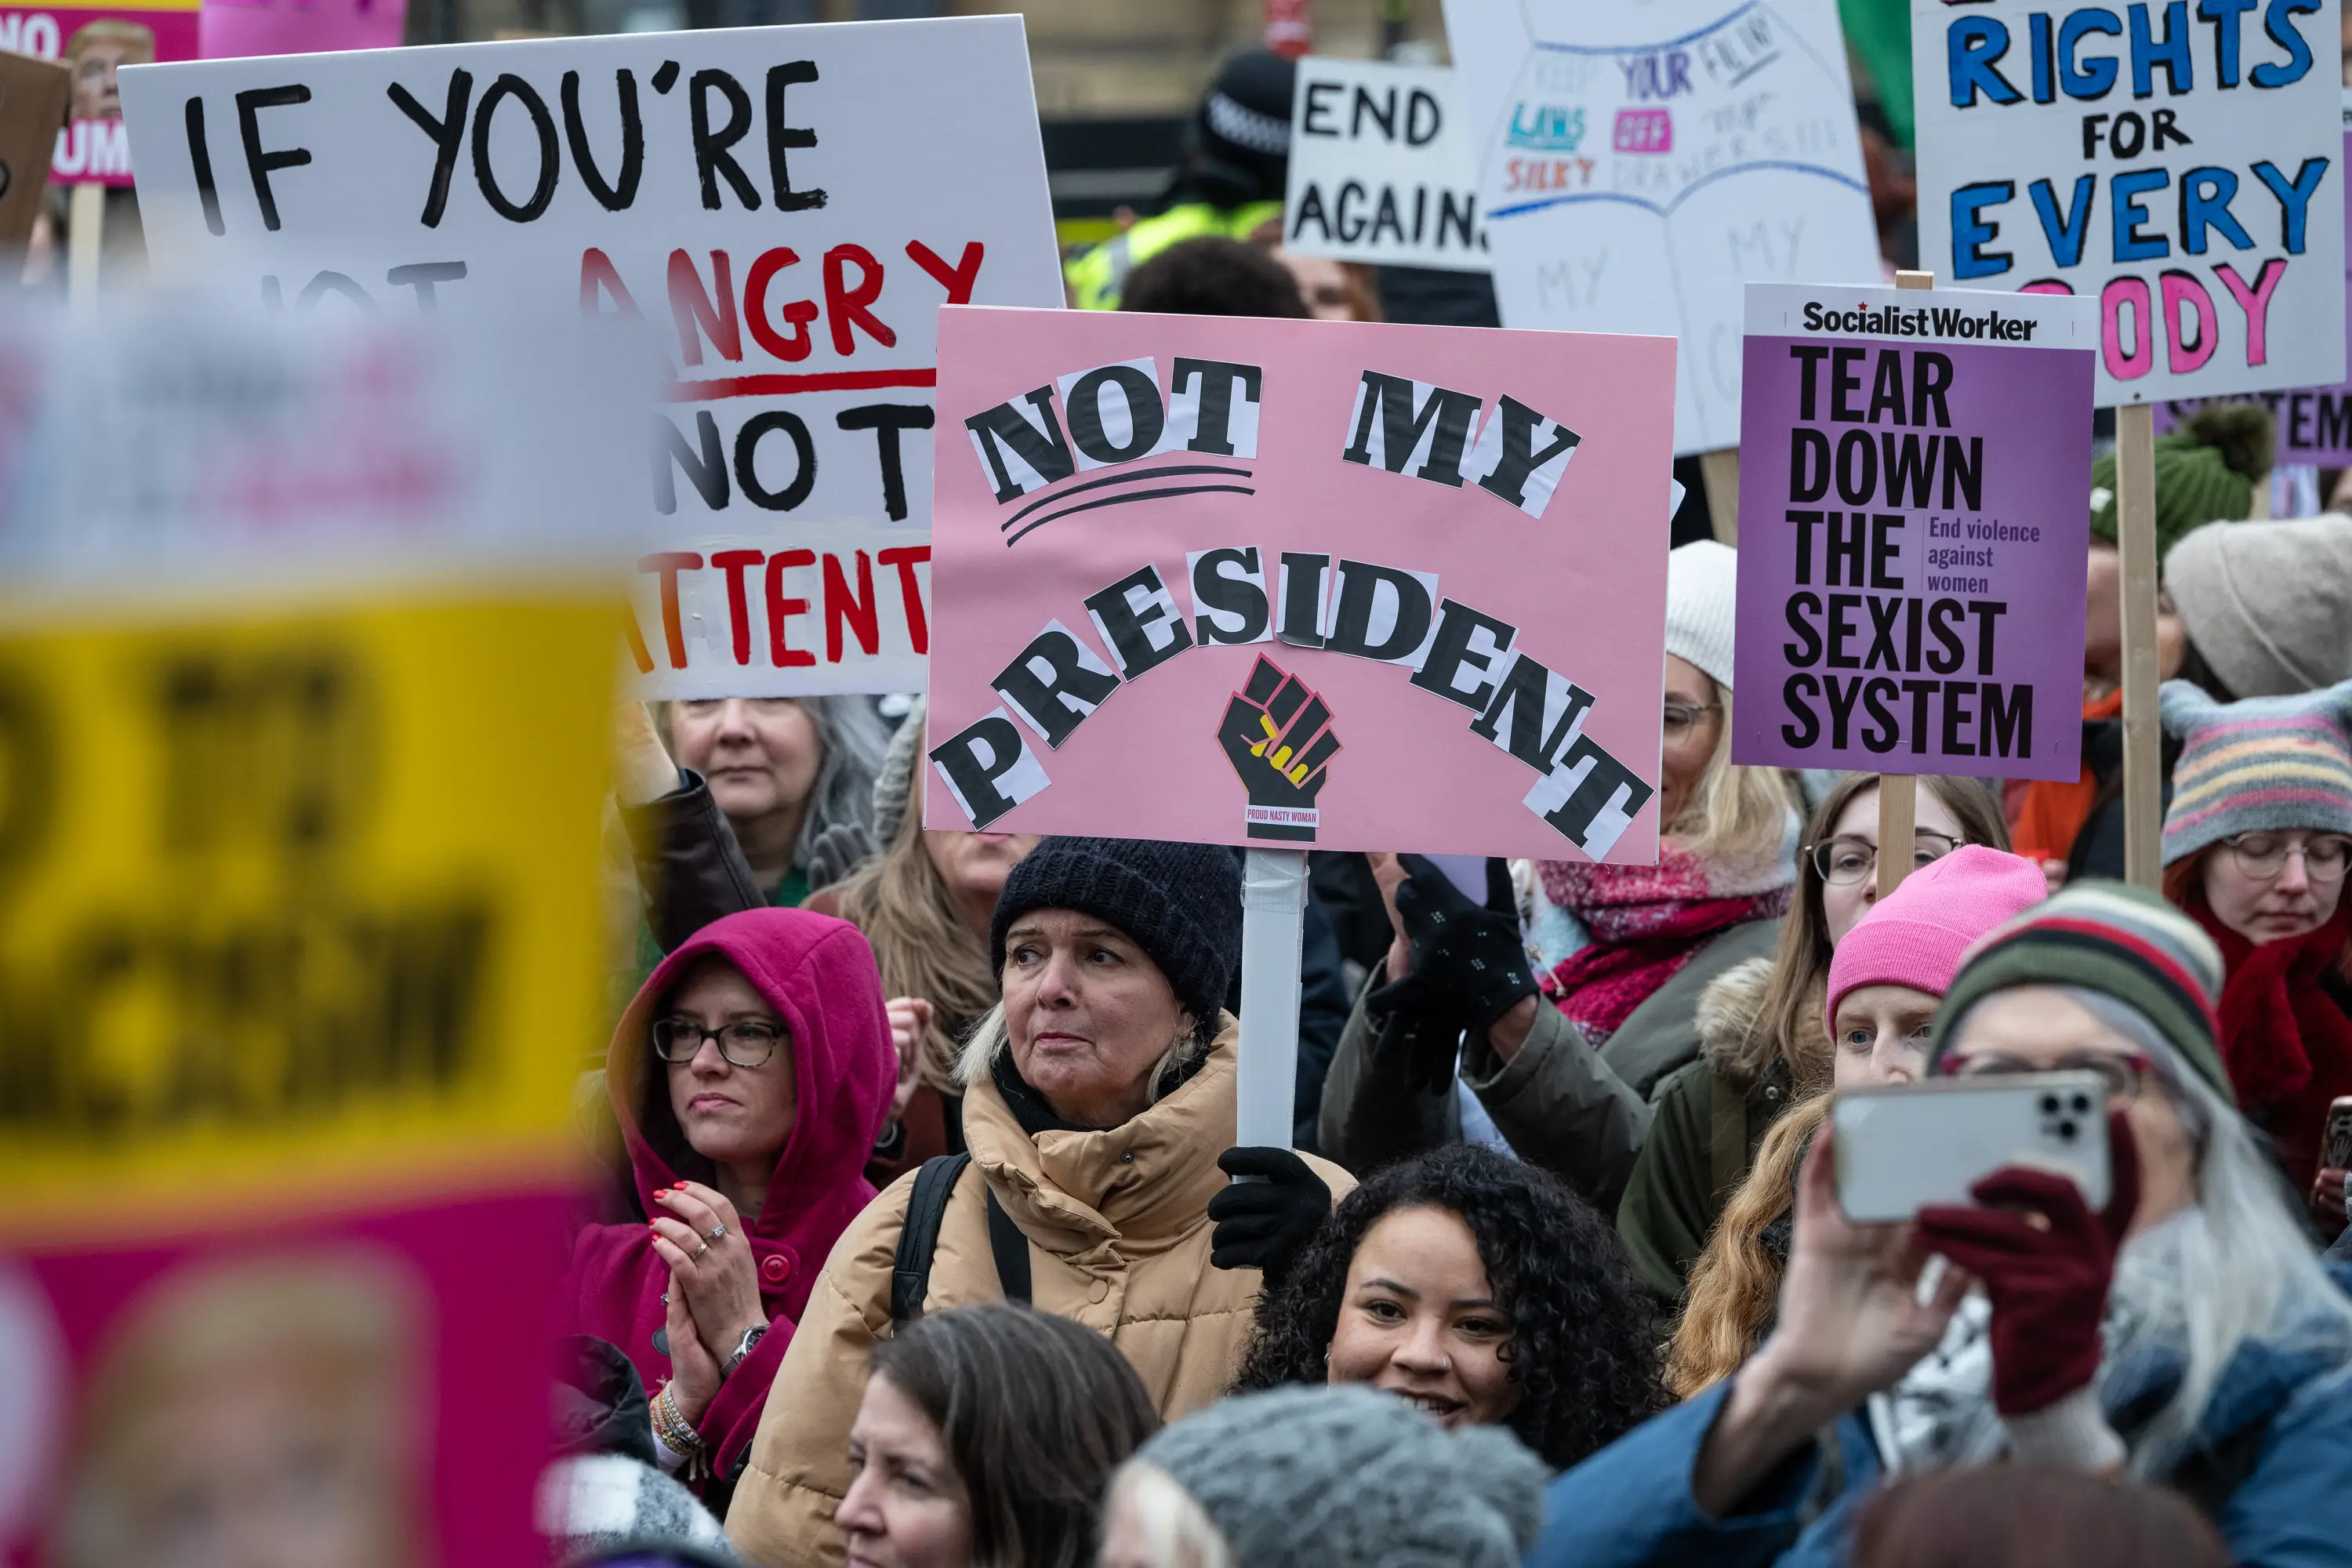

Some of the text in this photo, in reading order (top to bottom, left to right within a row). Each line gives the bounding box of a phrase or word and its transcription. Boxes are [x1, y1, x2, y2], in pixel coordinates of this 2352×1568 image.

[1615, 49, 1694, 100] YOUR
[1947, 0, 2321, 107] RIGHTS
[185, 60, 828, 236] IF YOU'RE
[1302, 82, 1442, 146] END
[2082, 108, 2193, 160] FOR
[1292, 180, 1489, 252] AGAIN
[1504, 158, 1596, 192] SILKY
[1951, 157, 2330, 281] EVERY
[2013, 258, 2288, 380] ODY
[1790, 345, 1954, 428] TEAR
[649, 404, 935, 521] NOT
[965, 357, 1582, 510] NOT MY
[1790, 427, 1984, 511] DOWN
[1785, 510, 1905, 590] THE
[1928, 546, 1994, 570] against
[1929, 517, 2040, 543] End violence
[625, 546, 931, 673] TTENT
[1927, 576, 1989, 594] women
[1784, 591, 2007, 676] SEXIST
[928, 546, 1654, 849] PRESIDENT
[1781, 673, 2034, 759] SYSTEM
[1247, 808, 1317, 823] PROUD NASTY WOMAN
